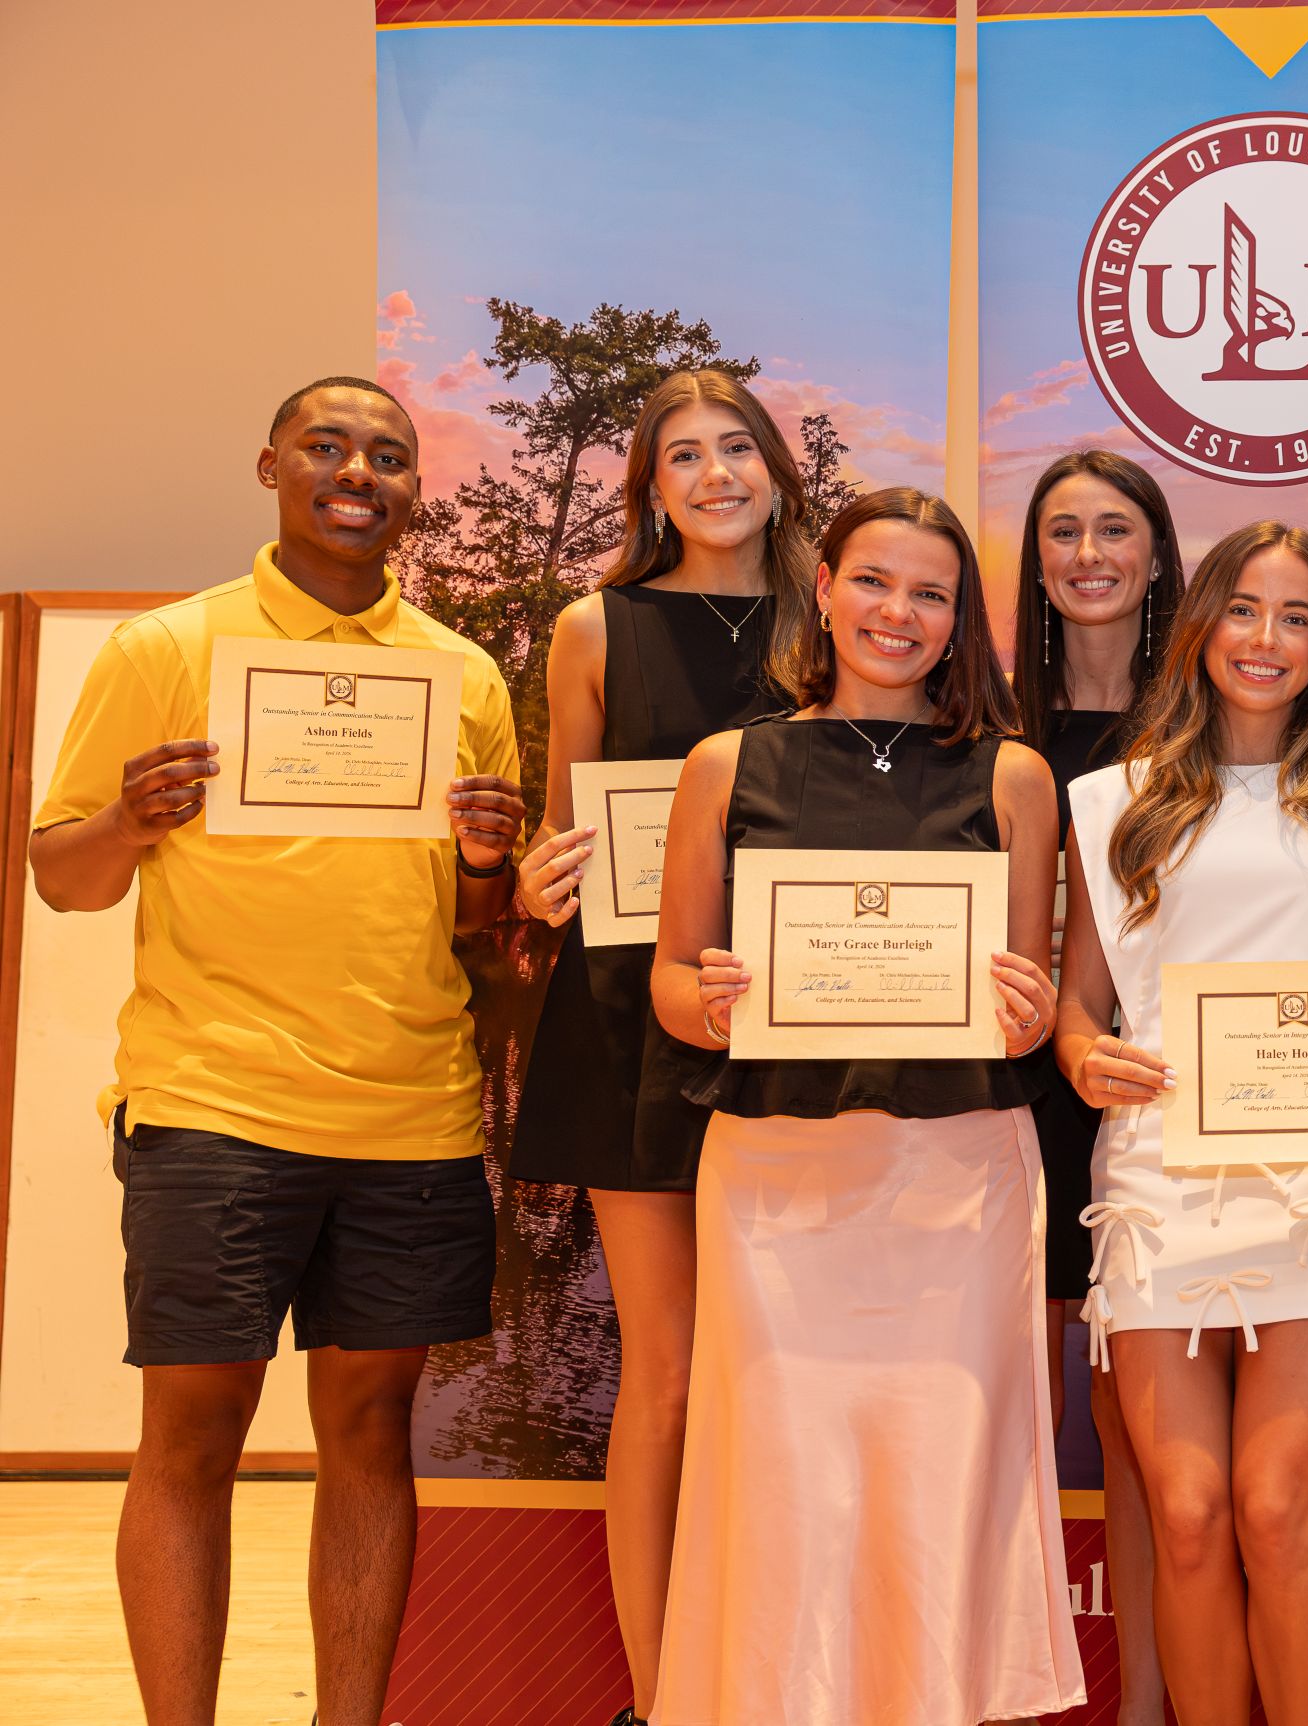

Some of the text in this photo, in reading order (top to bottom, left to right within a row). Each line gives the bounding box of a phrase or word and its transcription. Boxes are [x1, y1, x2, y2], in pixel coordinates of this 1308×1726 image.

[1098, 170, 1174, 359] UNIVERSITY
[1186, 140, 1223, 173] OF
[1184, 424, 1250, 466] EST.
[262, 707, 299, 716] Outstanding
[328, 711, 372, 719] Communication
[304, 726, 373, 739] Ashon Fields
[808, 939, 933, 952] Mary Grace Burleigh
[1256, 1049, 1289, 1061] Haley
